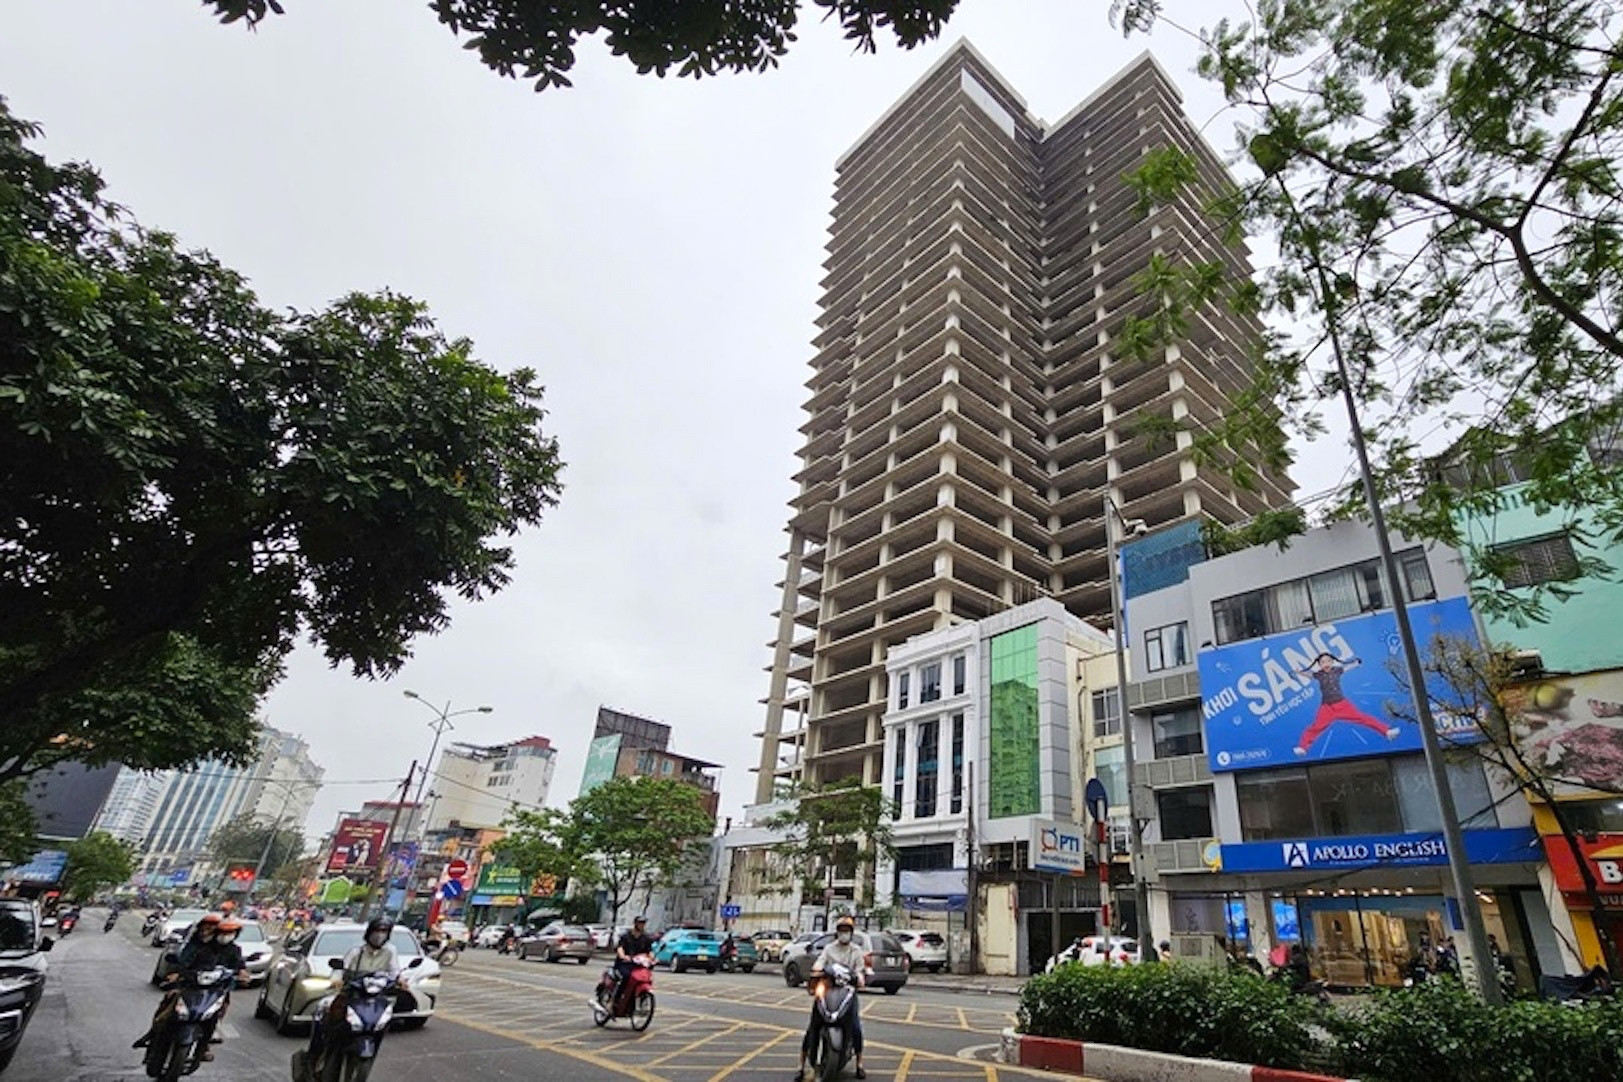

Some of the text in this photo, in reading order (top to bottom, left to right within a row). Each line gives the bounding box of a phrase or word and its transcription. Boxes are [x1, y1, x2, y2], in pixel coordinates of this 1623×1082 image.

[1237, 624, 1354, 715] SÁNG
[1060, 834, 1079, 851] PTI
[1313, 844, 1369, 860] APOLLO
[1374, 839, 1447, 858] ENGLISH
